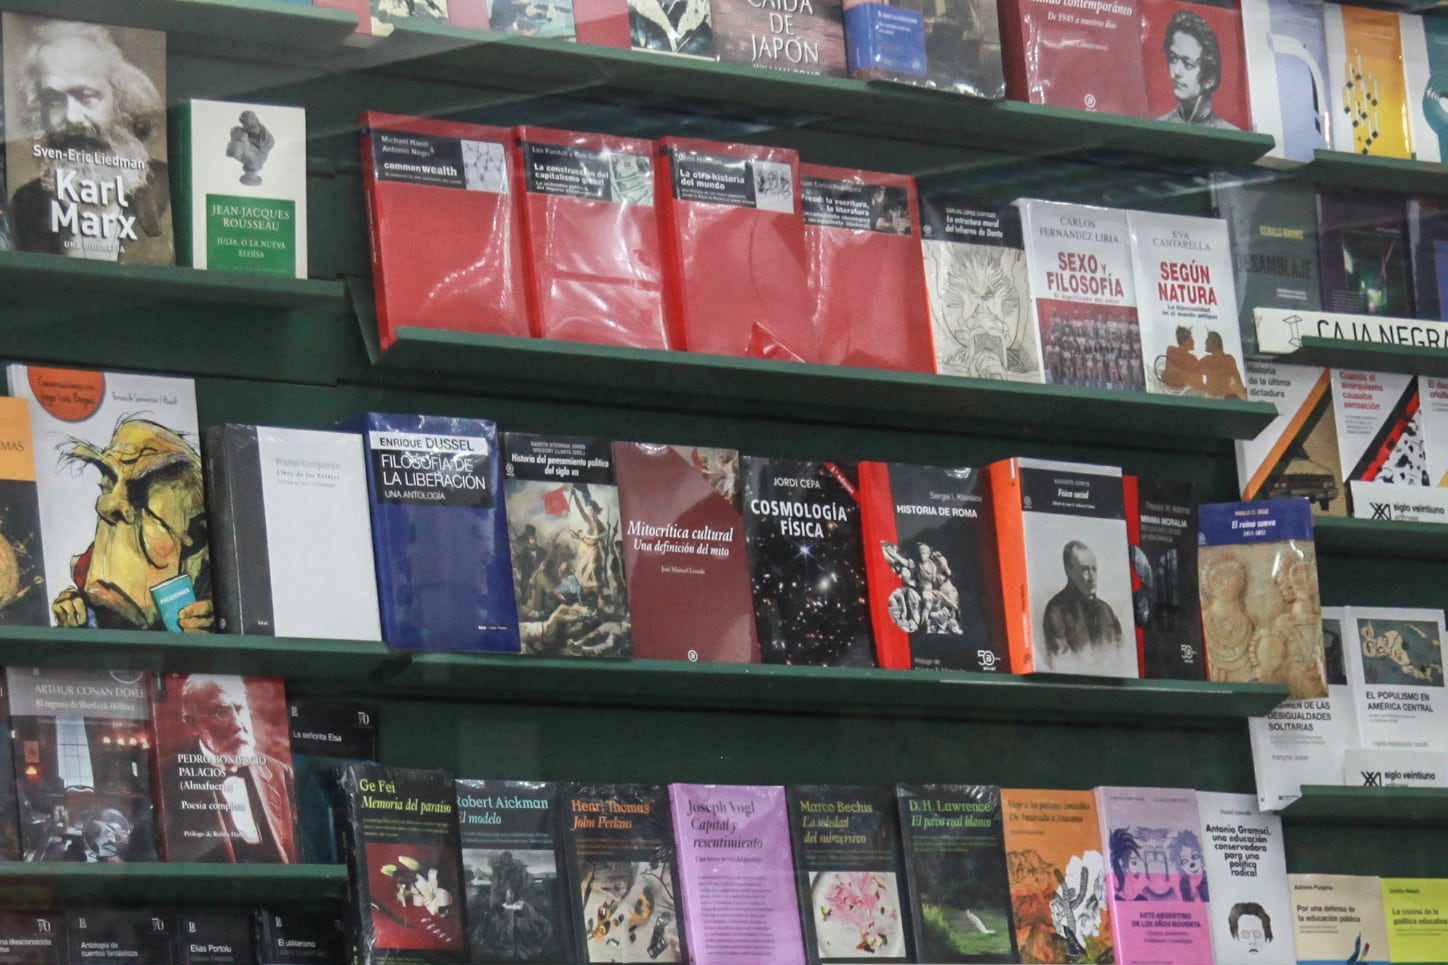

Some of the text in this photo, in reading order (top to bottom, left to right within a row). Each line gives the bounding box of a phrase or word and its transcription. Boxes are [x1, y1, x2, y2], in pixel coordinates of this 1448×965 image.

[34, 145, 144, 169] Sven-Eric Liedman
[55, 169, 128, 207] Karl
[51, 201, 137, 240] Marx
[212, 205, 289, 218] JEAN-JACQUES
[223, 218, 279, 231] ROUSSEAU
[1173, 231, 1189, 239] EVA
[1153, 238, 1210, 252] CANTARELLA
[1058, 252, 1097, 273] SEXO
[1161, 260, 1210, 284] SEGÚN
[1047, 272, 1124, 297] FILOSOFÍA
[1158, 282, 1217, 305] NATURA
[380, 437, 474, 451] ENRIQUE DUSSEL
[381, 454, 473, 472] FILOSOFÍA DE
[384, 472, 486, 490] LA LIBERACIÓN
[751, 499, 848, 521] COSMOLOGÍA
[897, 505, 977, 518] HISTORIA DE ROMA
[627, 520, 733, 542] Mitocrítica cultural
[781, 519, 824, 538] FÍSICA
[360, 779, 396, 793] Ge Fei
[361, 797, 403, 810] Memoria
[405, 799, 418, 812] del
[497, 796, 548, 809] Aickman
